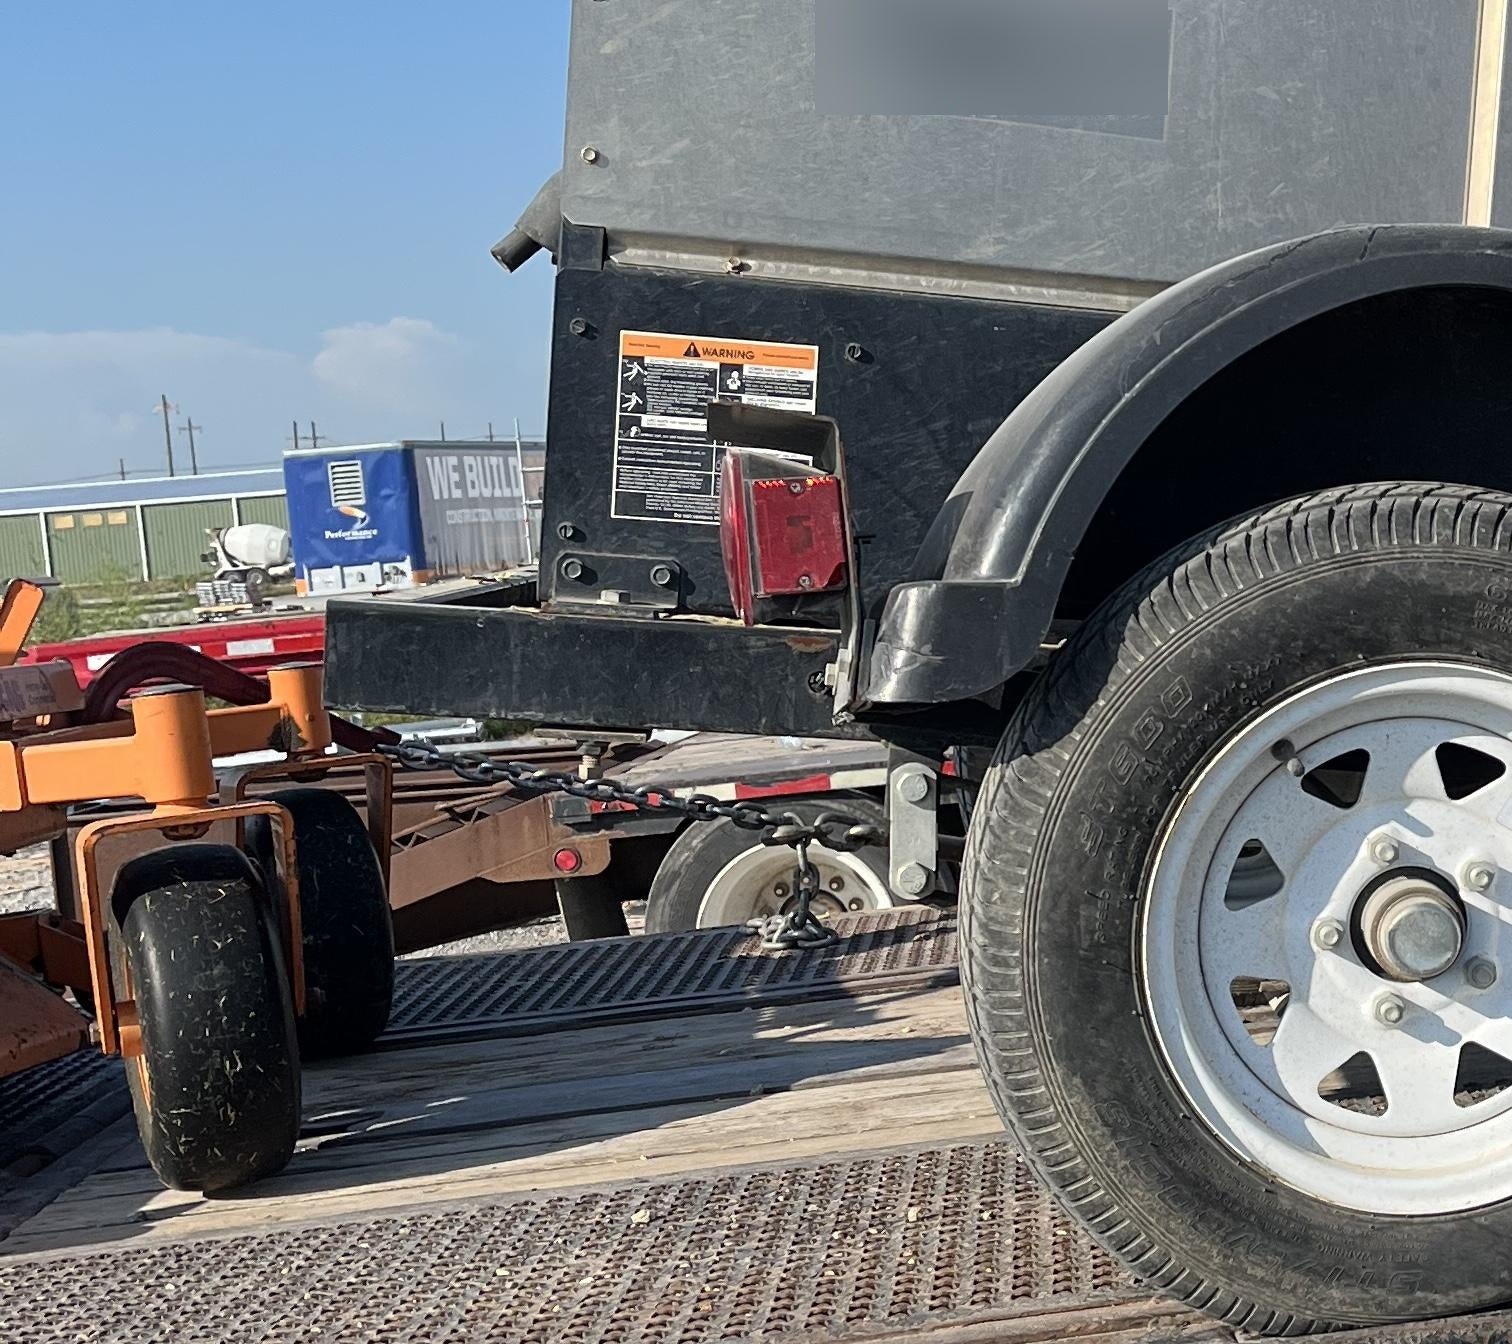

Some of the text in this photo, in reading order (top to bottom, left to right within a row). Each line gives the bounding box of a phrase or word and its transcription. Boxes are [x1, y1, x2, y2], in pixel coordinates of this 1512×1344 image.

[702, 346, 755, 360] WARNING
[425, 455, 522, 500] WE BUILD
[324, 527, 378, 540] Performance
